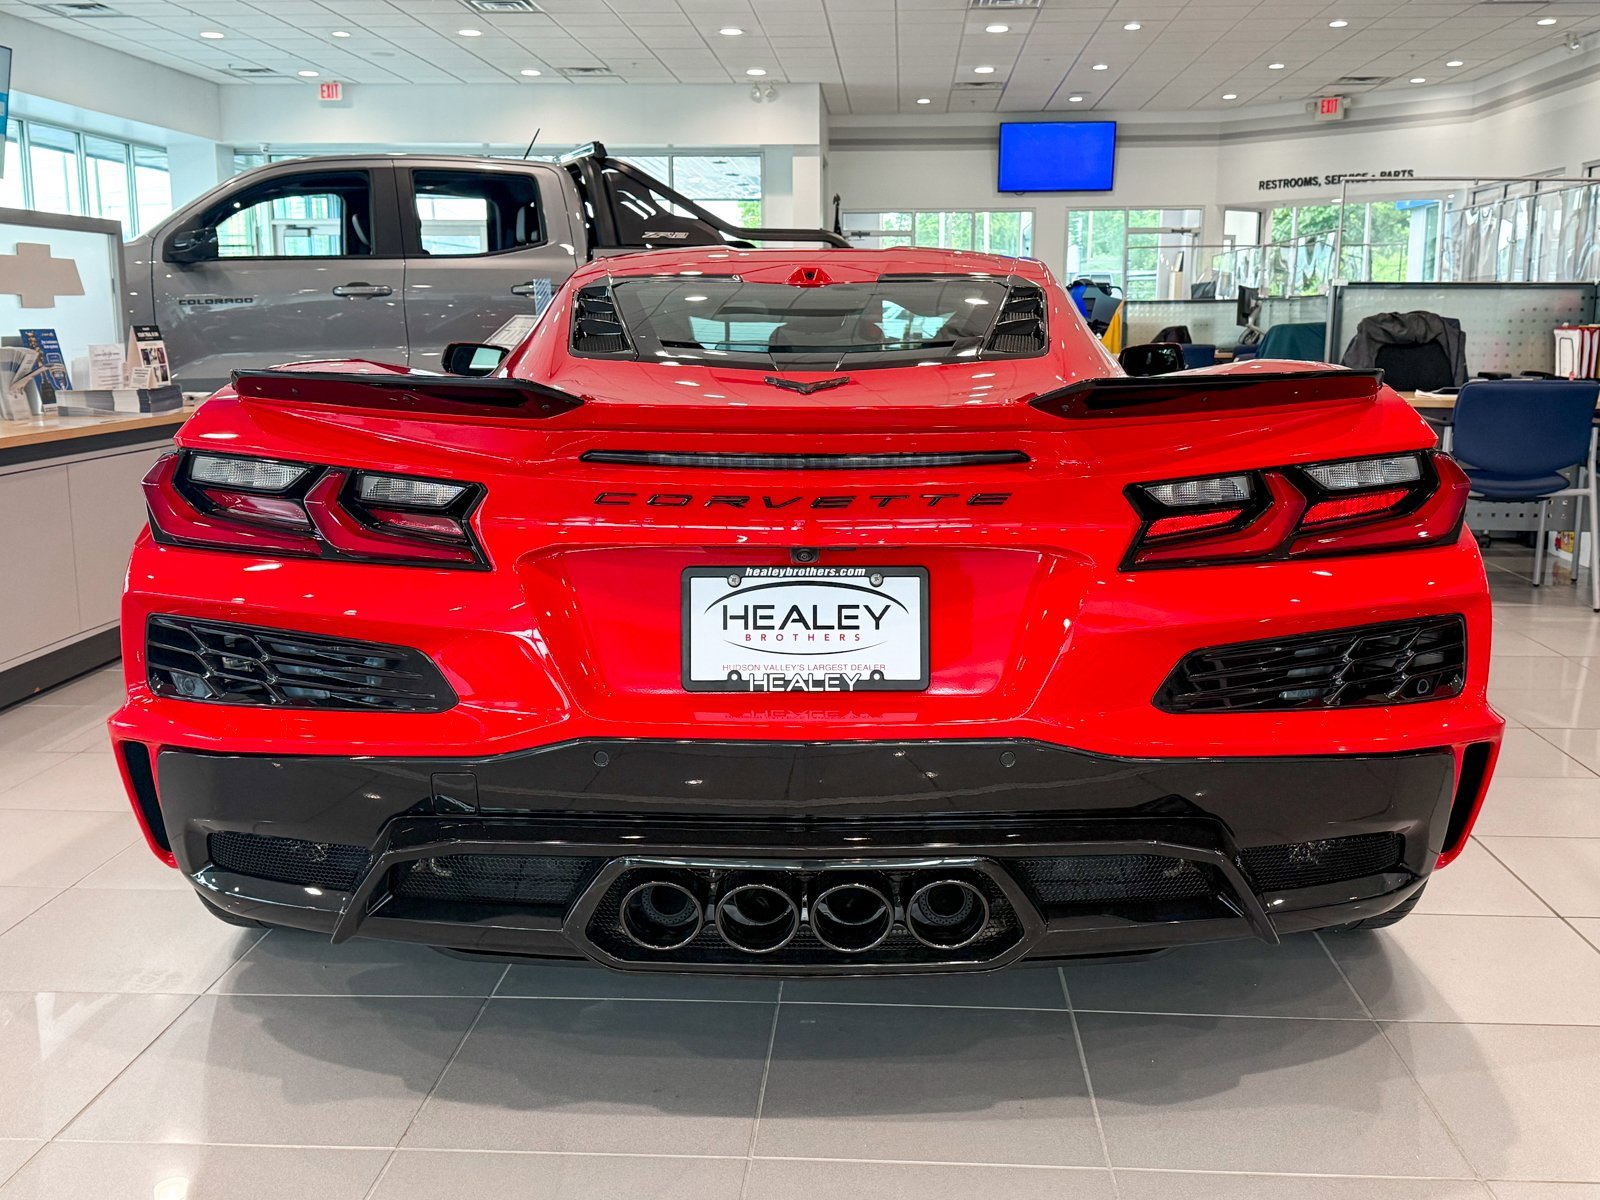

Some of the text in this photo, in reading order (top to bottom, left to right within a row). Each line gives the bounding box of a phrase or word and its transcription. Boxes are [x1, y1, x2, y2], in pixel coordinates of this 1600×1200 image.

[320, 83, 339, 99] EXIT
[1321, 98, 1338, 114] EXIT
[1258, 176, 1322, 191] RESTROOMS,
[179, 297, 253, 305] COLORADO
[593, 492, 1012, 509] CORVETTE
[745, 567, 866, 578] healeybrothers.com
[722, 604, 891, 631] HEALEY
[745, 633, 861, 642] BROTHERS
[749, 672, 862, 692] HEALEY
